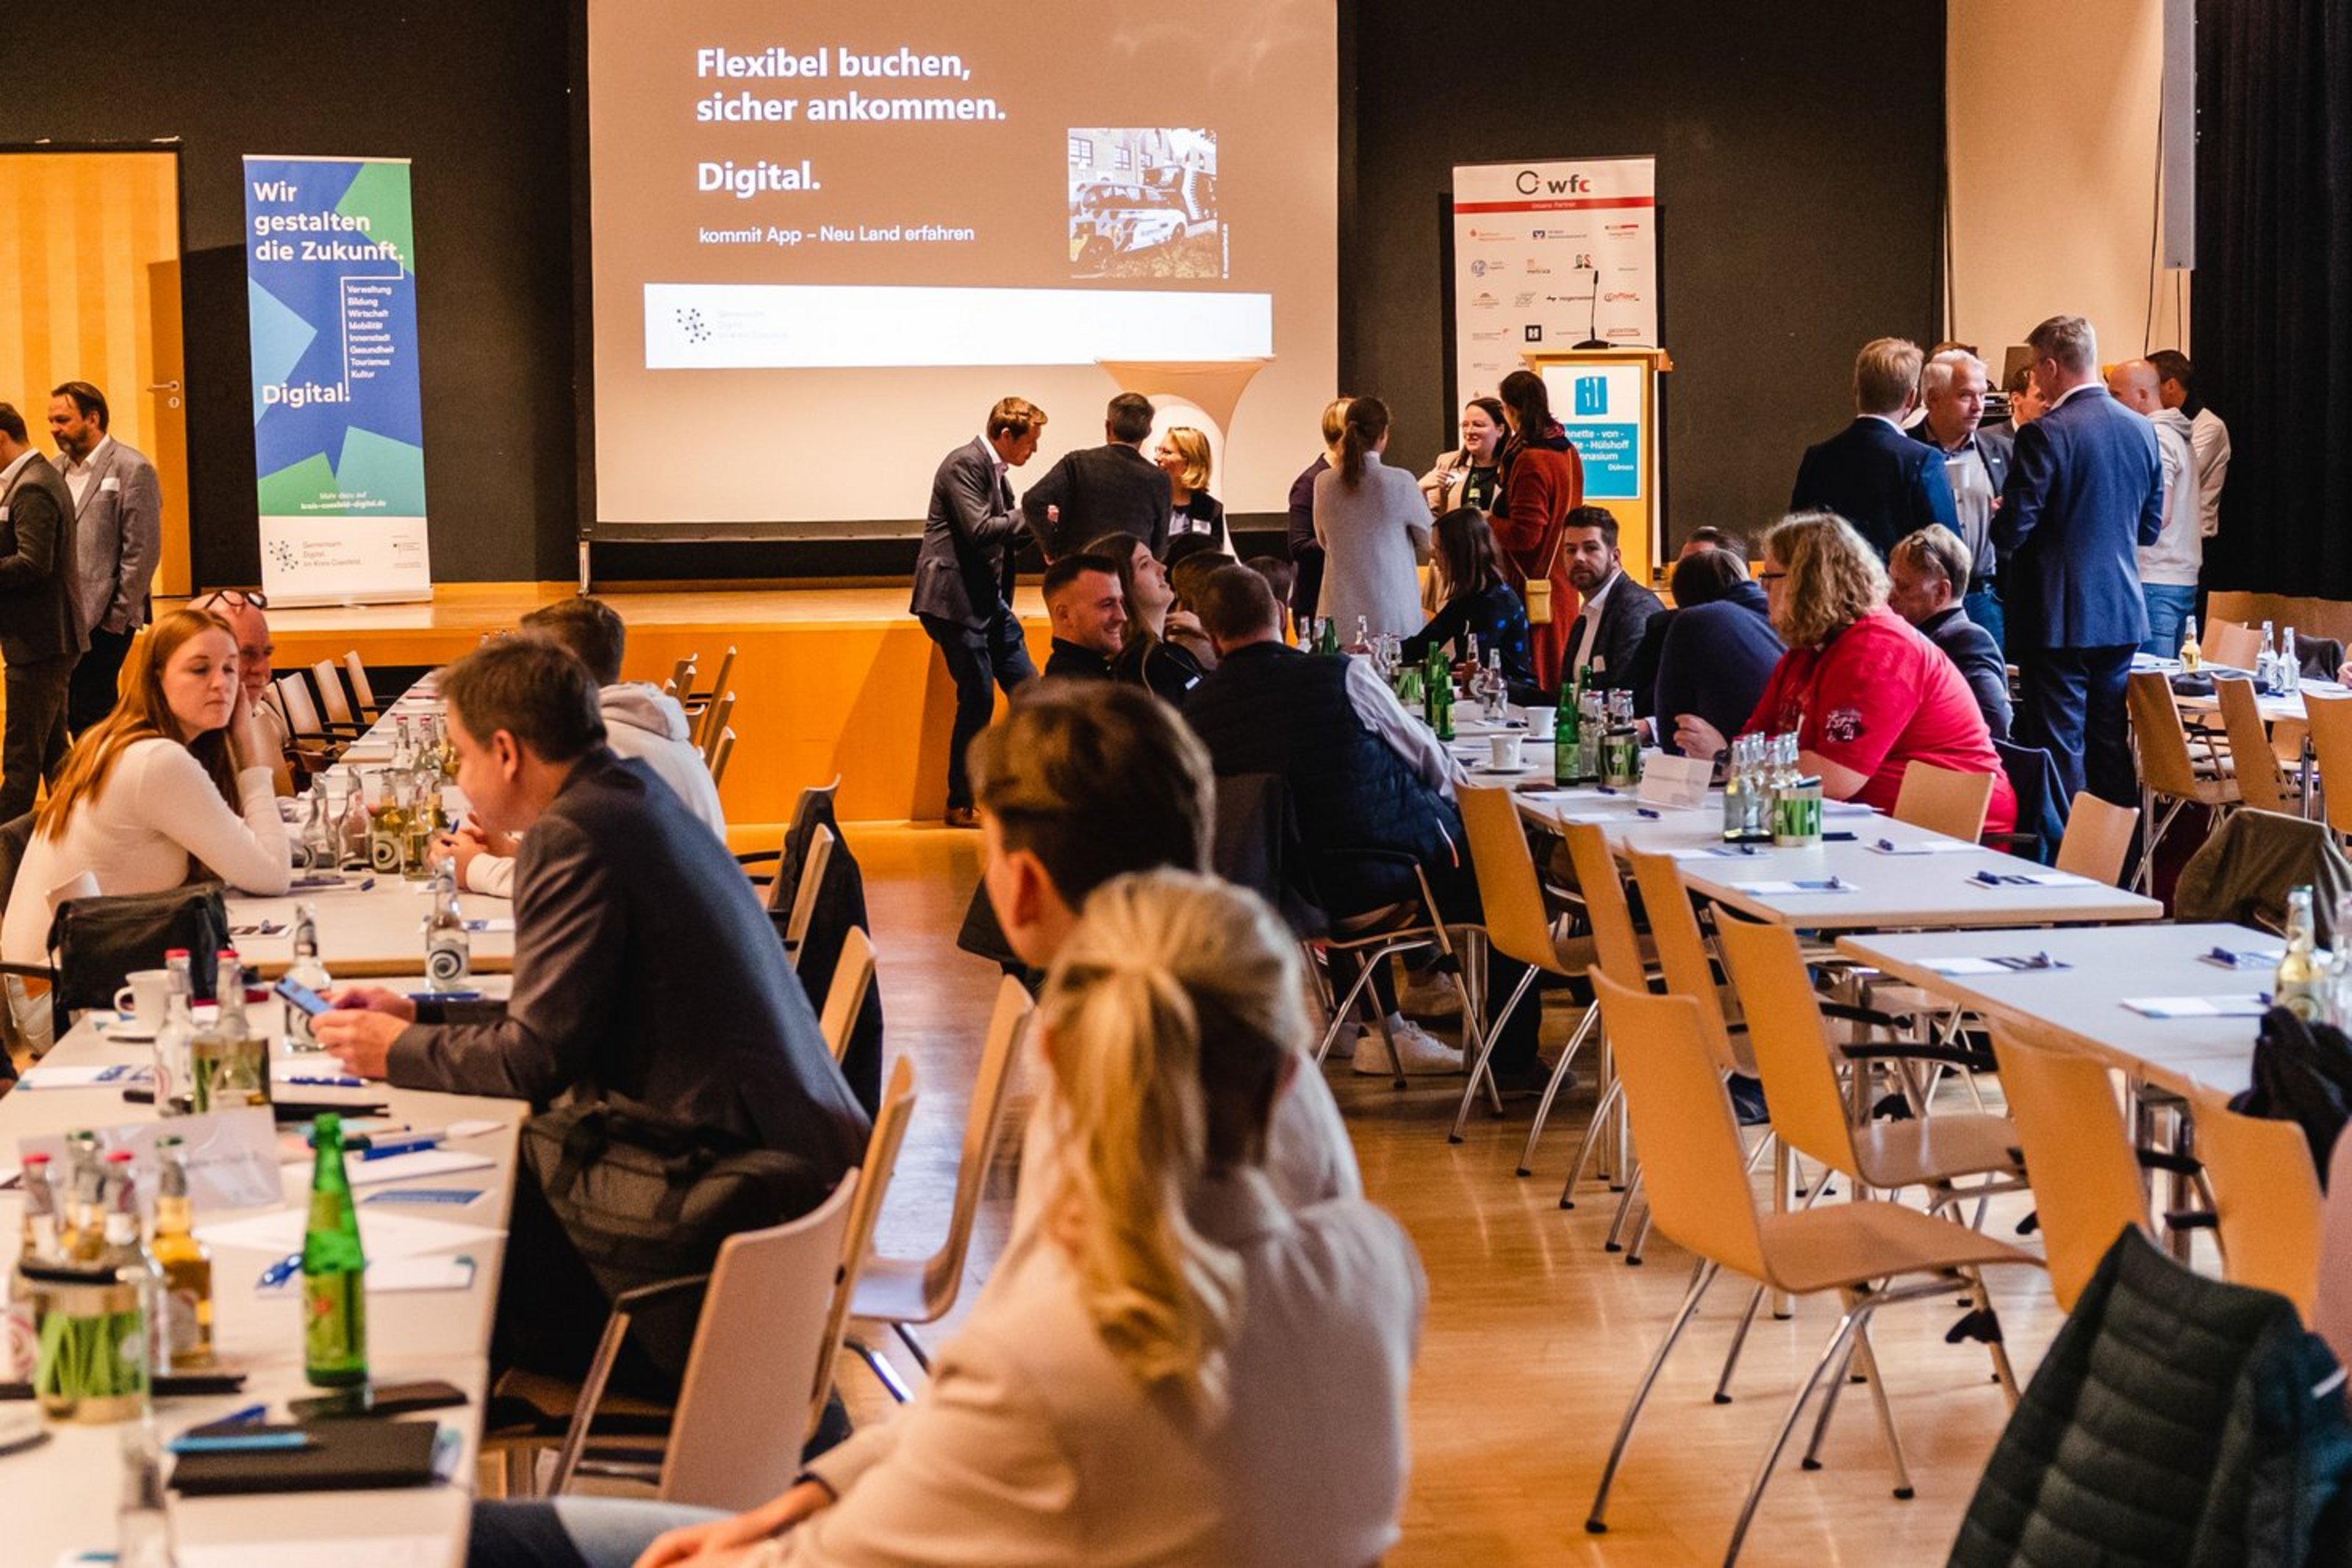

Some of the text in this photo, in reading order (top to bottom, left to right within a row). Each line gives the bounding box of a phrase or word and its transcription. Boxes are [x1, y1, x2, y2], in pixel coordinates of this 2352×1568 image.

[698, 48, 971, 81] Flexibel buchen,
[697, 91, 1006, 121] sicher ankommen.
[698, 160, 821, 199] Digital.
[1547, 174, 1590, 193] wfc
[253, 181, 298, 202] Wir
[254, 211, 370, 235] gestalten
[699, 226, 762, 243] kommit
[766, 226, 803, 246] App
[820, 226, 855, 242] Neu
[859, 225, 900, 242] Land
[904, 225, 975, 241] erfahren
[255, 240, 404, 261] die Zukunft.
[347, 285, 392, 295] Verwaltung
[347, 297, 379, 307] Bildung
[348, 309, 389, 317] Wirtschaft
[348, 321, 383, 330] Mobilität
[349, 334, 391, 342] Innenstadt
[350, 345, 395, 353] Gesundheit
[351, 358, 390, 366] Tourismus
[351, 369, 375, 378] Kultur
[262, 382, 351, 407] Digital!
